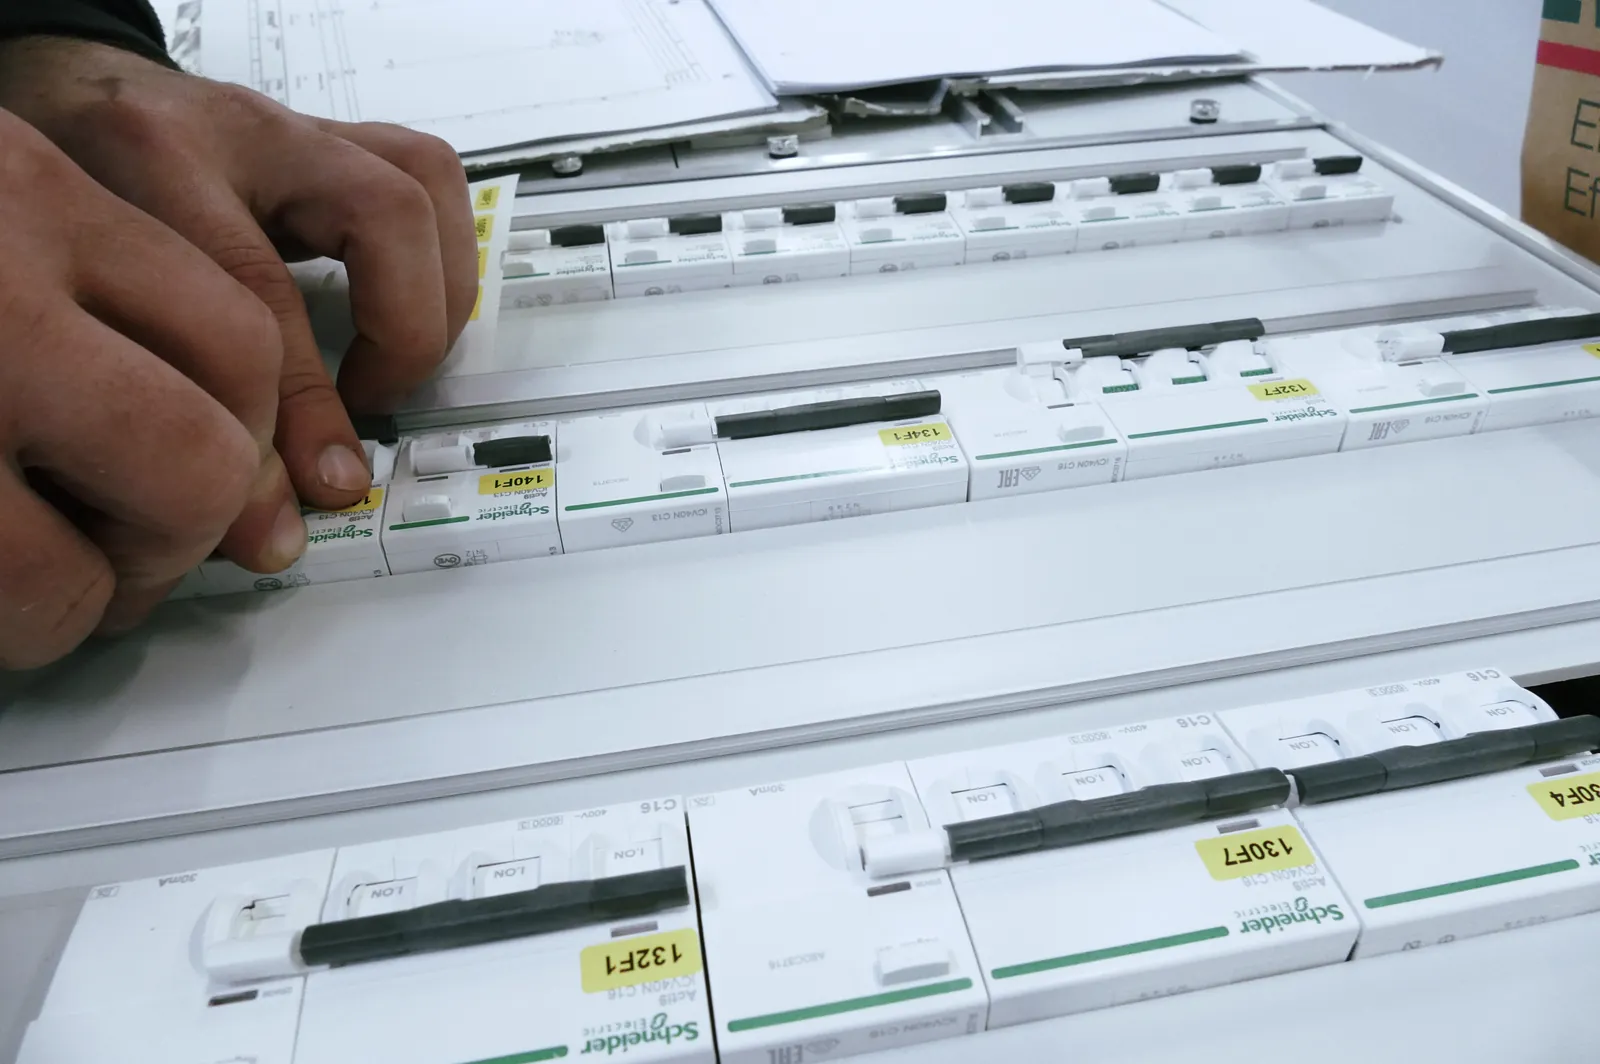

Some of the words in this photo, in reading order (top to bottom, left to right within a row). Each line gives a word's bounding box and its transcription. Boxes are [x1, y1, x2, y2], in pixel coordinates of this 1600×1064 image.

[1263, 384, 1307, 396] 132F7
[1273, 408, 1338, 423] Schneider
[893, 427, 940, 441] 134F1
[494, 474, 544, 489] 140F1
[997, 469, 1020, 489] EAC
[475, 506, 550, 521] Schneider
[478, 504, 518, 513] Electric
[651, 512, 670, 522] C13
[307, 528, 374, 544] Schneide
[311, 527, 342, 535] Electr
[1465, 668, 1500, 682] C16
[1176, 714, 1211, 729] C16
[748, 783, 785, 797] 30mA
[1548, 783, 1600, 808] 30F4
[640, 798, 677, 814] C16
[1222, 837, 1293, 866] 130F7
[158, 872, 198, 888] 30mA
[1233, 901, 1290, 919] Electric
[1240, 904, 1344, 935] Schneider
[605, 943, 683, 977] 132F1
[582, 1018, 646, 1037] Electric
[580, 1021, 699, 1056] Schneider
